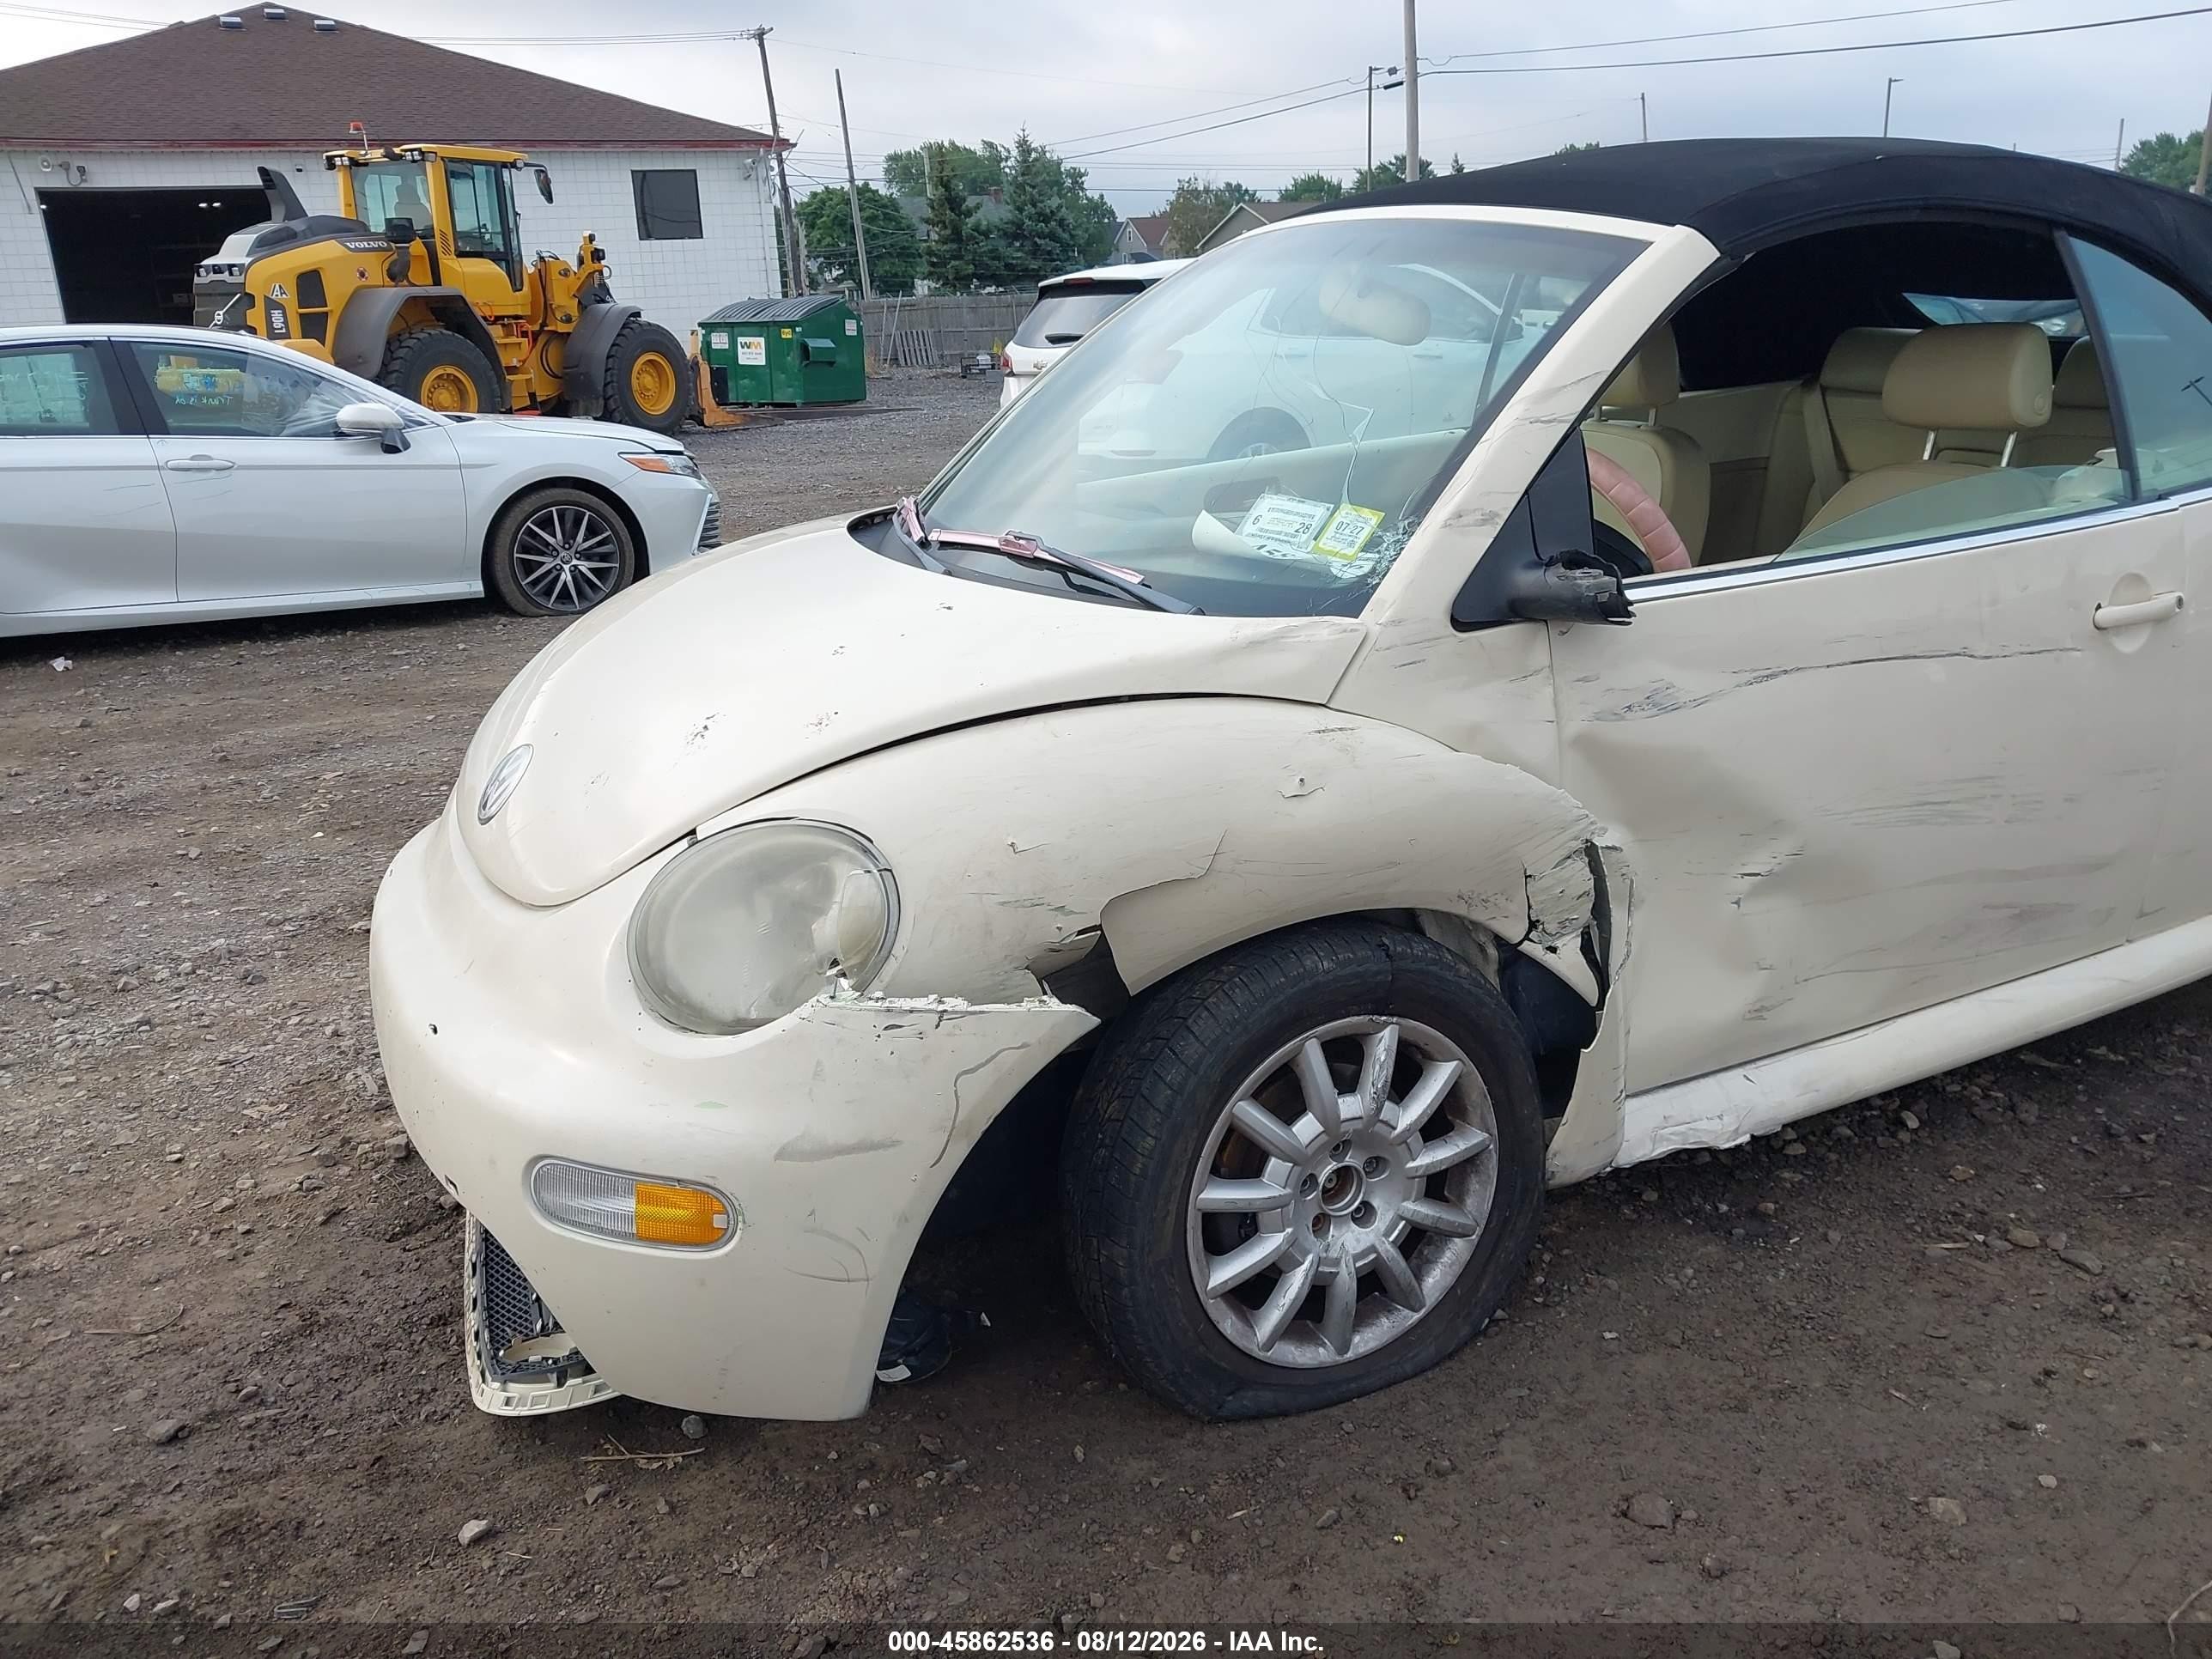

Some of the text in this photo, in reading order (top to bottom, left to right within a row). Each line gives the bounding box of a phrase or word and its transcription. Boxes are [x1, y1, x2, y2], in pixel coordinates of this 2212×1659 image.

[270, 309, 286, 333] L90H
[739, 341, 762, 349] WM
[1252, 514, 1262, 526] 6
[1294, 522, 1313, 535] 28
